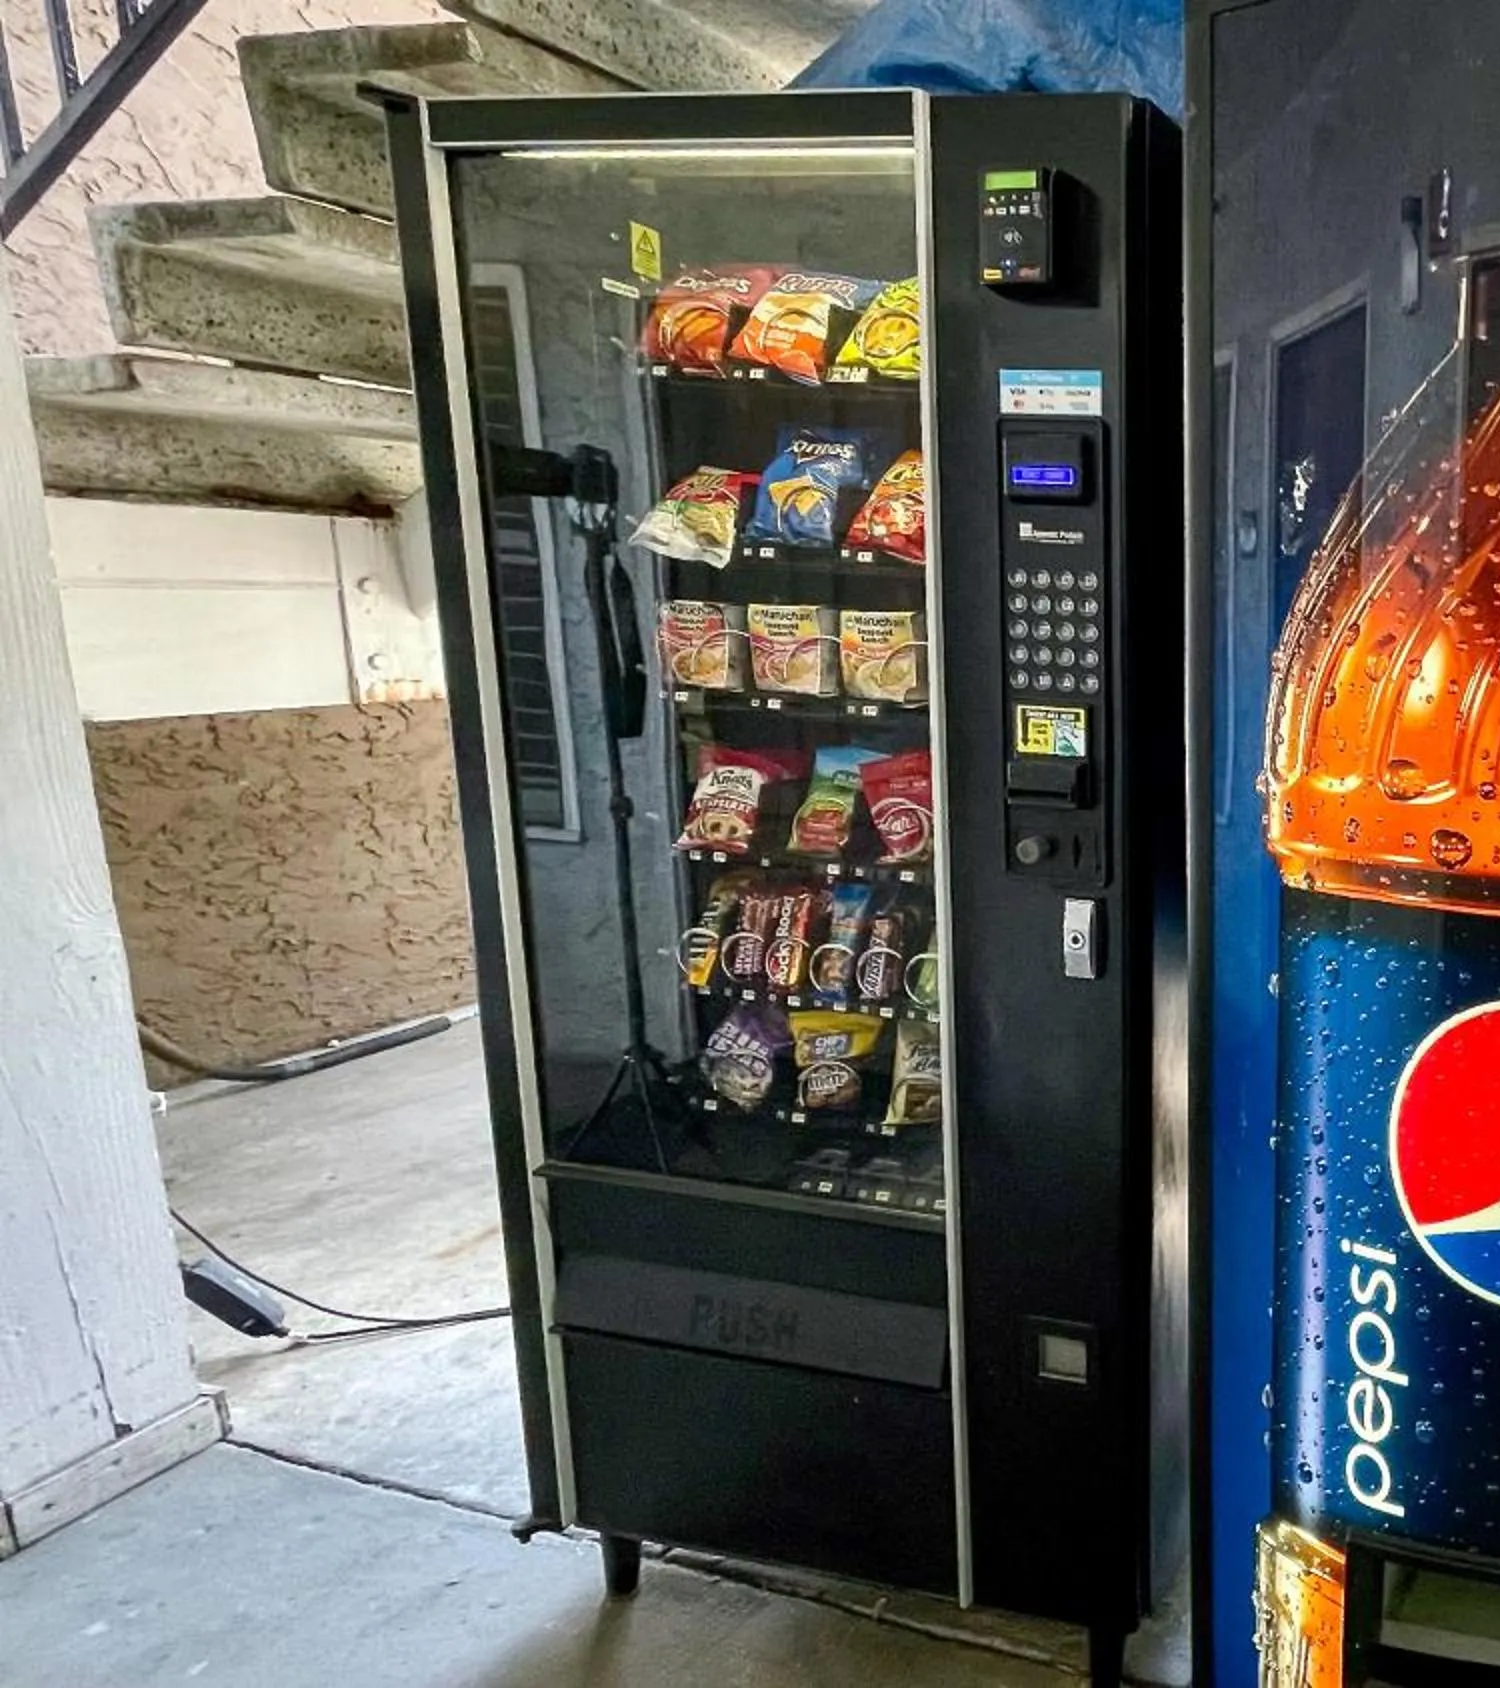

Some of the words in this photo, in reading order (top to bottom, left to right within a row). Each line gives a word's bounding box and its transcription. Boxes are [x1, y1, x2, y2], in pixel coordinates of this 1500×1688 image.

[761, 609, 813, 622] Maruchan
[853, 616, 905, 628] Maruchan
[776, 896, 795, 937] Road
[690, 1293, 799, 1350] PUSH
[1341, 1238, 1409, 1517] pepsi
